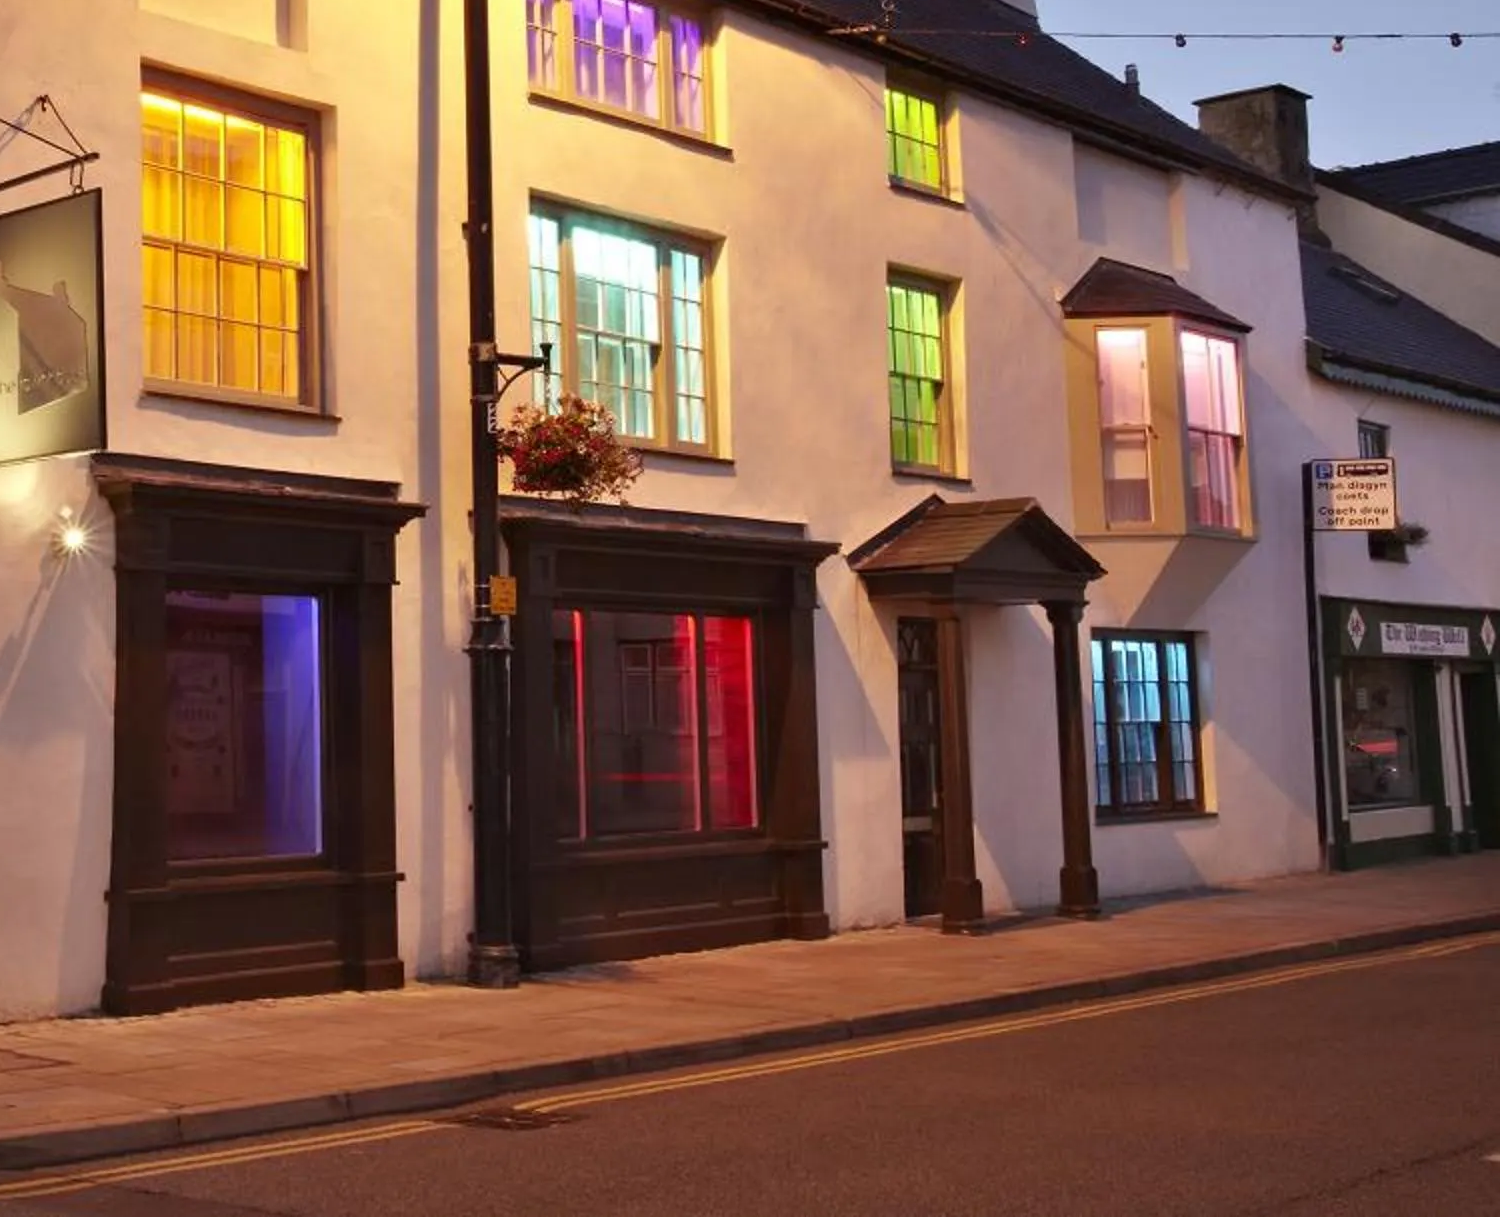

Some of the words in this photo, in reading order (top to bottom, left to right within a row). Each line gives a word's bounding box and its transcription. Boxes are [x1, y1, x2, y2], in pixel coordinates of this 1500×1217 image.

[1318, 506, 1357, 515] Coach
[1360, 506, 1389, 517] drop
[1327, 517, 1345, 525] off
[1349, 517, 1380, 527] point
